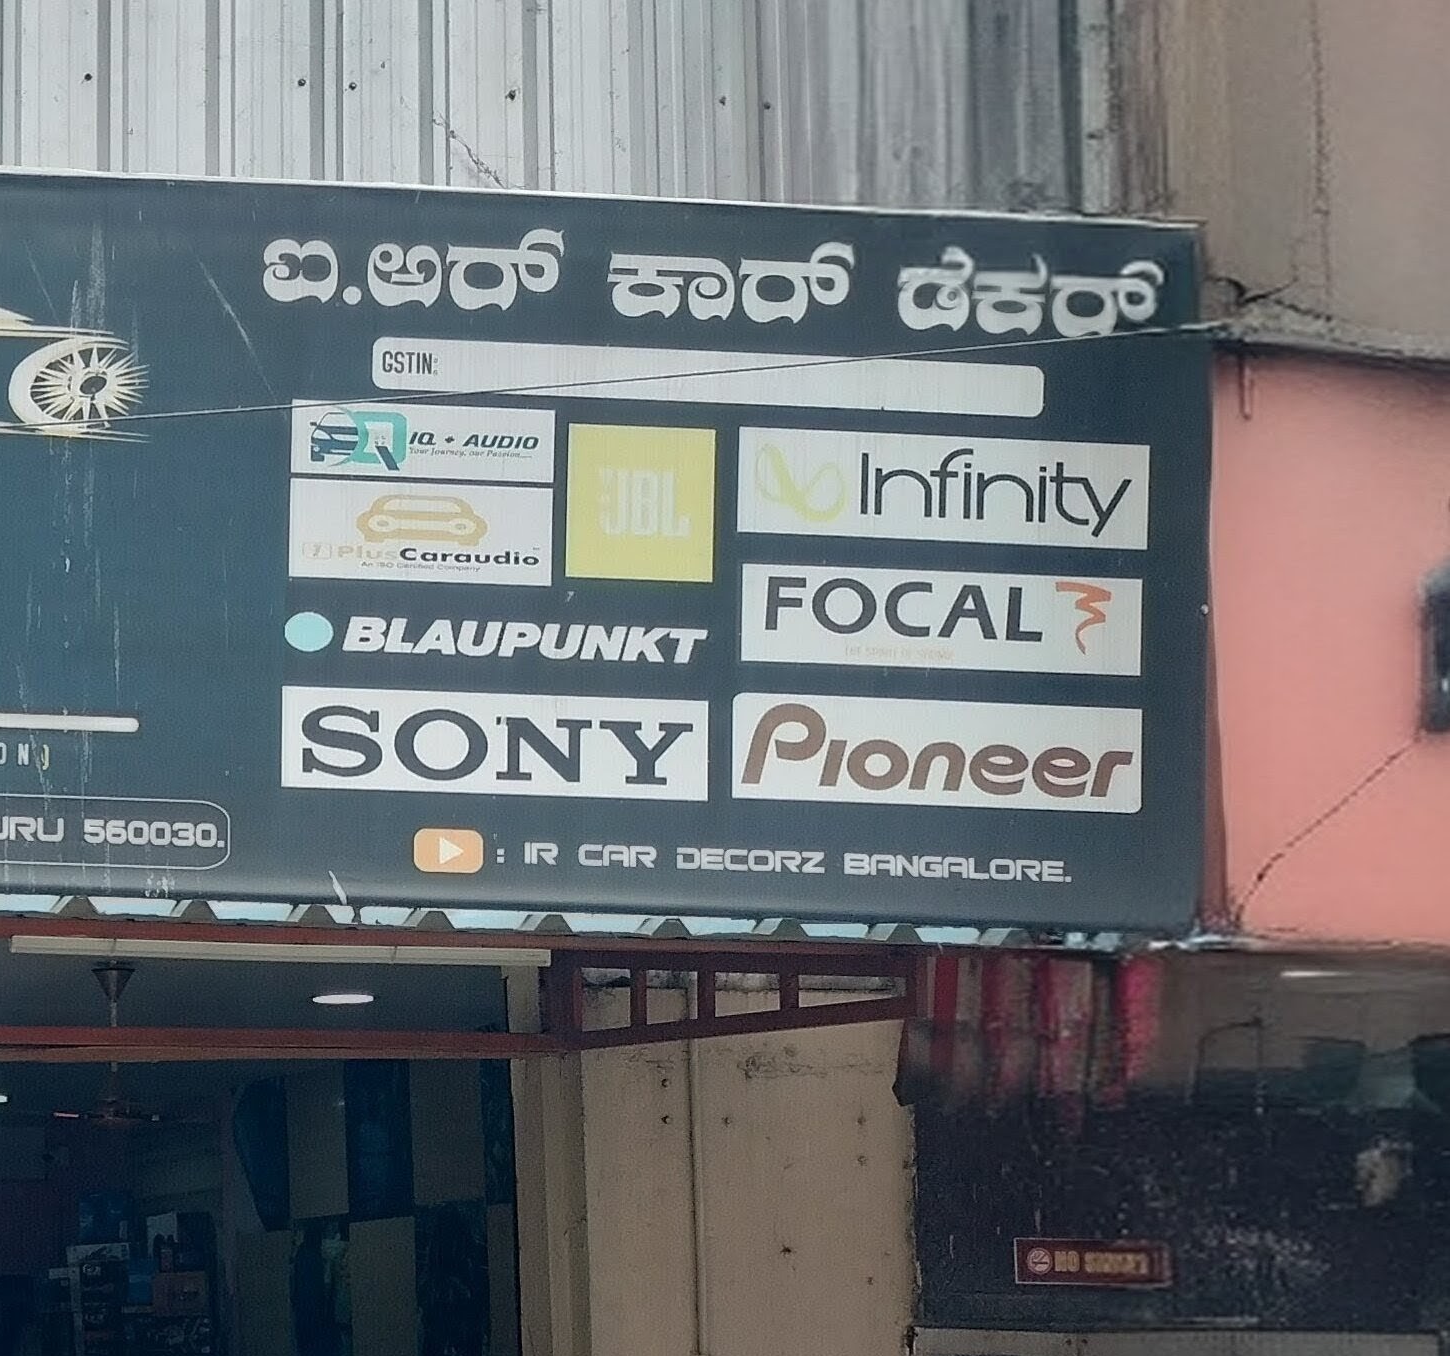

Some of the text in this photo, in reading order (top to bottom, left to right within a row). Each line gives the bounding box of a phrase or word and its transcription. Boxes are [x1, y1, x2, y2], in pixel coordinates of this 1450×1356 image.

[607, 241, 855, 324] ಕಾರ್
[409, 431, 436, 446] IQ
[463, 434, 540, 450] AUDIO
[858, 446, 1133, 539] Infinity
[343, 615, 708, 664] BLAUPUNKT
[765, 576, 1043, 646] FOCAL
[299, 705, 695, 789] SONY
[743, 703, 1134, 800] Pioneer
[83, 818, 225, 849] 560030.
[524, 842, 558, 866] IR
[578, 843, 659, 870] CAR
[676, 847, 825, 875] DECORZ
[843, 853, 1073, 883] BANGALORE.
